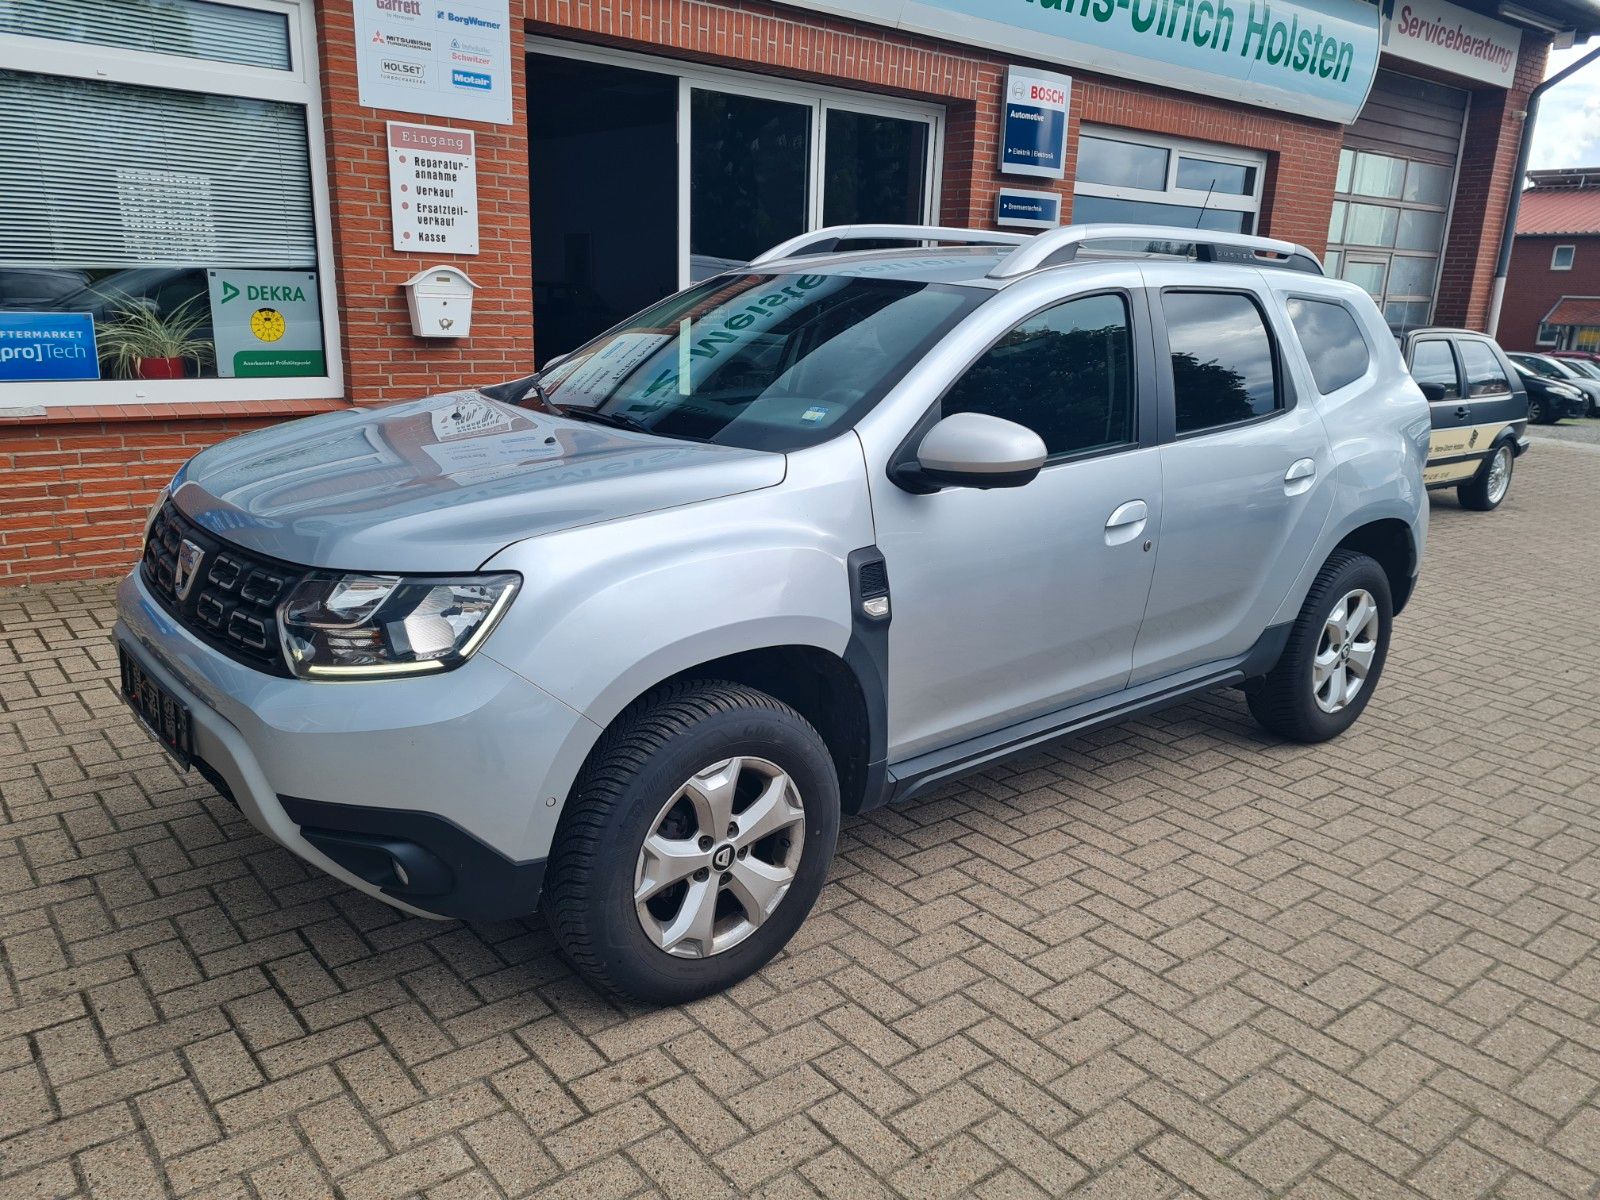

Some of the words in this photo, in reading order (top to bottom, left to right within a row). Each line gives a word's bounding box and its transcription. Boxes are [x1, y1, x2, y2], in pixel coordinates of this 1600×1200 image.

[376, 0, 421, 16] Garrett
[448, 13, 501, 30] BorgWarner
[386, 35, 431, 47] MITSUBISHI
[1241, 3, 1354, 82] Holsten
[1398, 5, 1514, 74] Serviceberatung
[452, 52, 491, 65] Schwitzer
[384, 62, 421, 75] HOLSET
[454, 74, 489, 86] Motair
[1030, 86, 1064, 104] BOSCH
[1010, 109, 1045, 122] Automotive
[402, 131, 464, 150] Eingang
[414, 156, 468, 171] Reparatur-
[415, 169, 457, 182] annahme
[416, 185, 453, 198] Verkauf
[416, 203, 468, 216] Ersatzteil-
[417, 216, 454, 227] verkauf
[418, 232, 446, 243] Kasse
[247, 285, 306, 302] DEKRA
